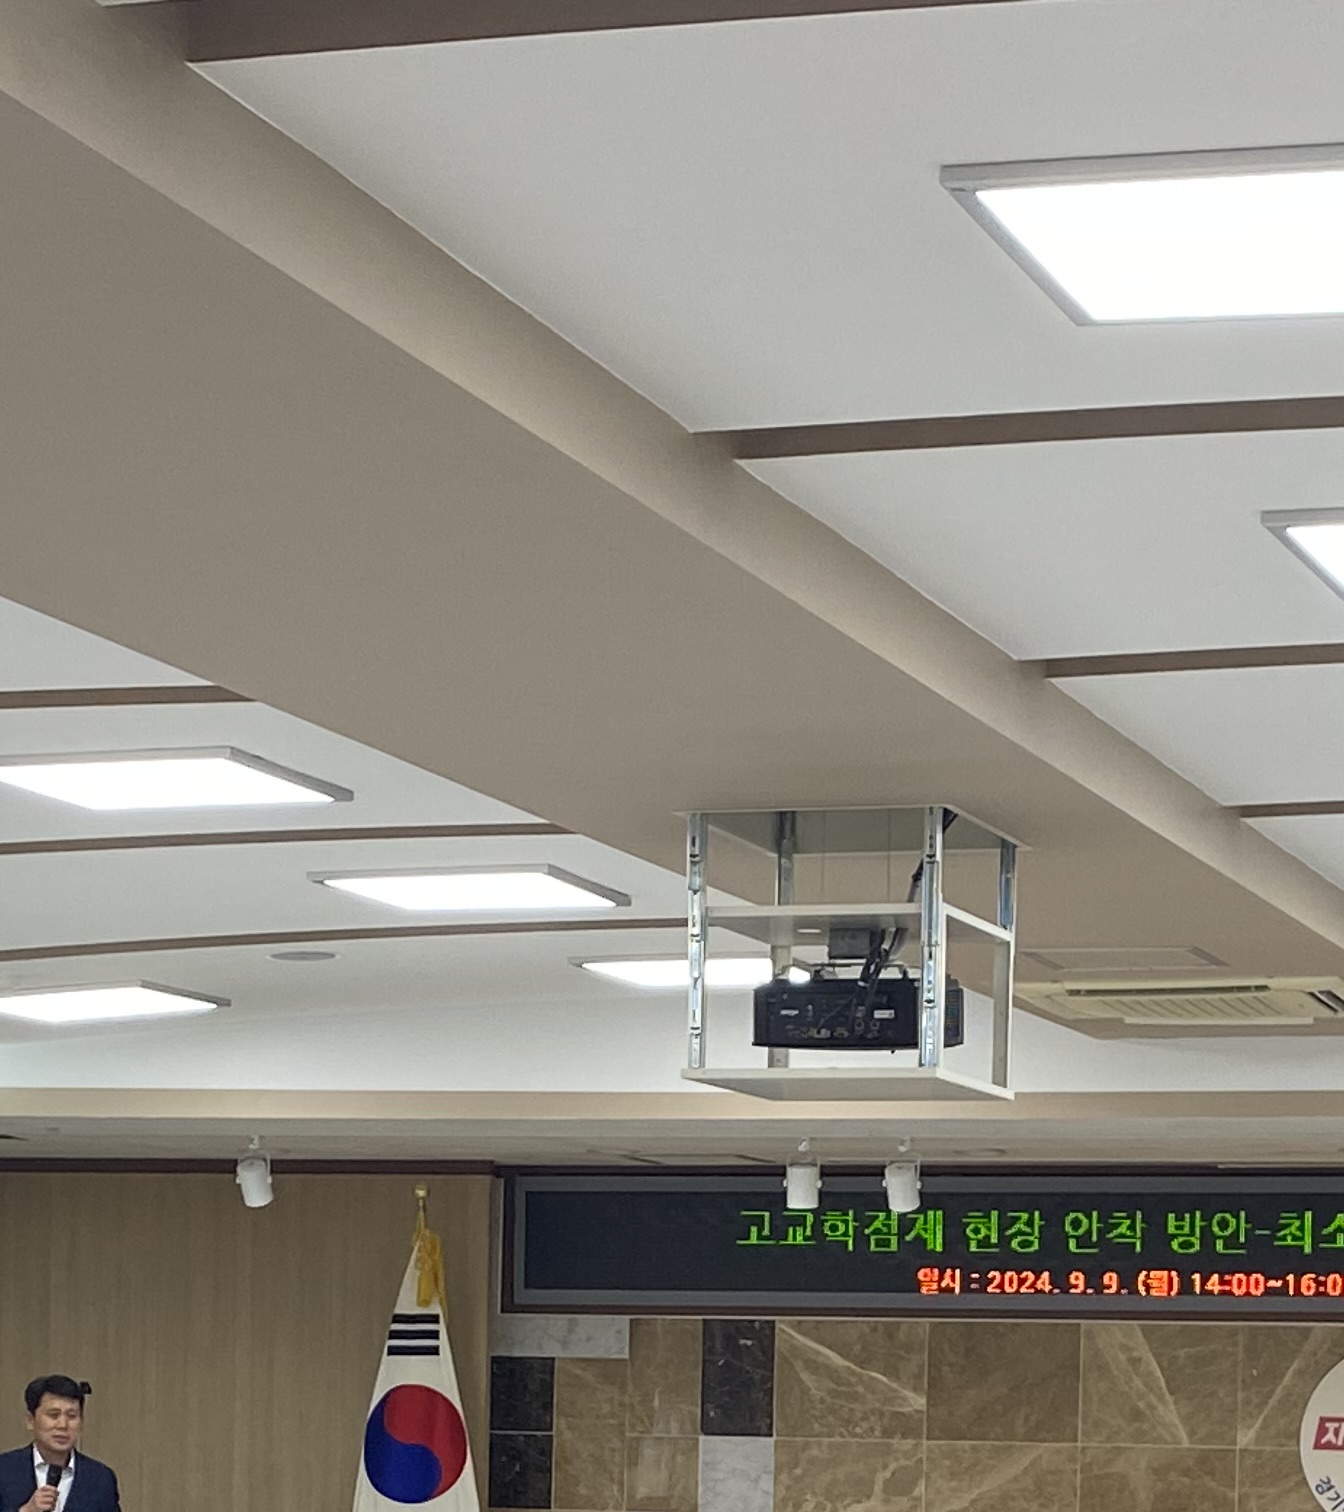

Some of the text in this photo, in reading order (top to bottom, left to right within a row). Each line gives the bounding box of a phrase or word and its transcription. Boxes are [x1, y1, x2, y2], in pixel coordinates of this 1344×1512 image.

[735, 1209, 945, 1253] 고교학점제
[962, 1210, 1046, 1253] 현장
[1064, 1211, 1148, 1254] 안착
[916, 1266, 962, 1296] 일시
[1136, 1269, 1181, 1298] (월)
